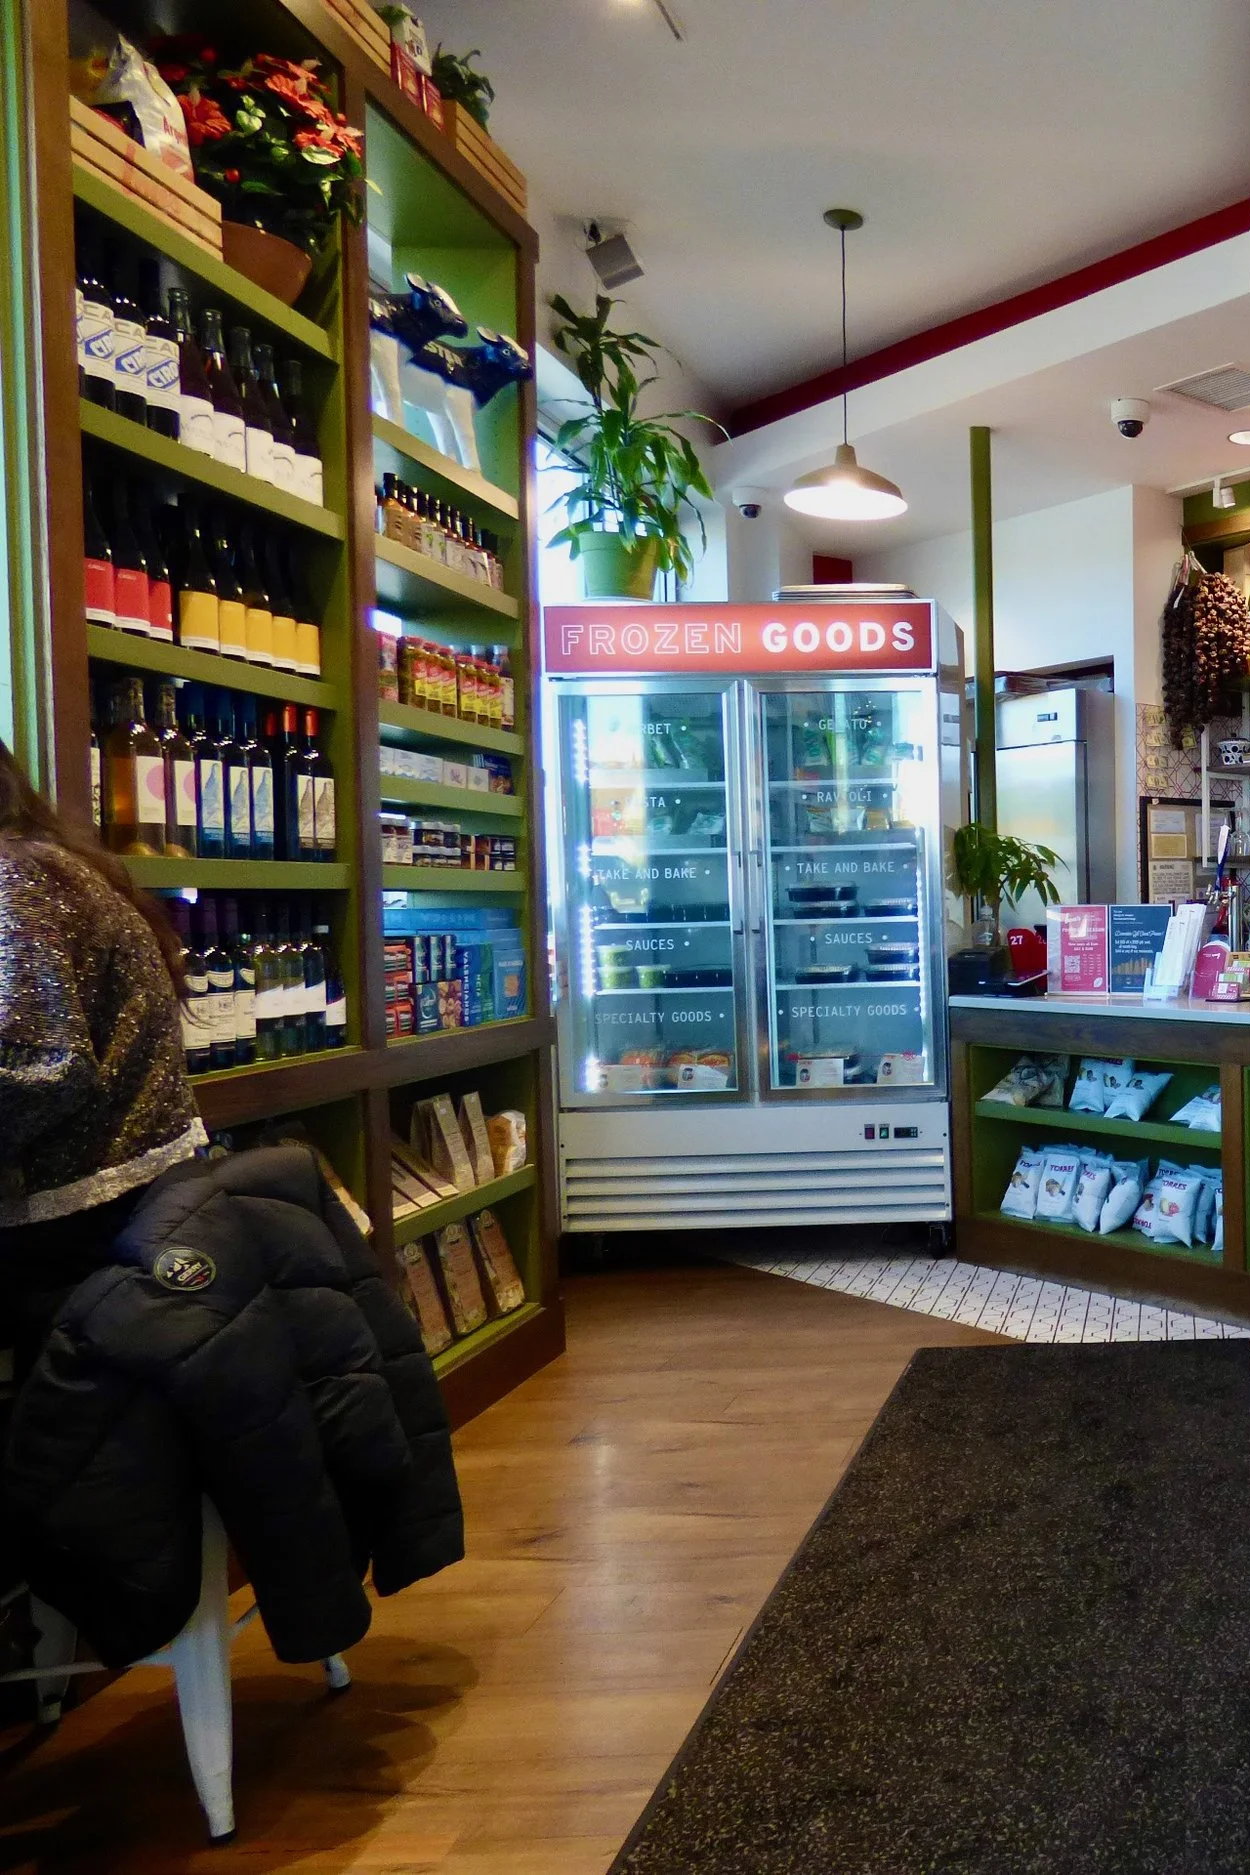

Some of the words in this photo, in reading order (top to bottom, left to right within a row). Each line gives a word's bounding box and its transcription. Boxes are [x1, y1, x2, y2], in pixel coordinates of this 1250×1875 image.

[561, 623, 742, 655] FROZEN
[762, 621, 915, 653] GOODS
[635, 868, 660, 880] AND
[665, 867, 697, 879] BAKE
[797, 862, 829, 874] TAKE
[834, 862, 859, 873] AND
[863, 861, 895, 873] BAKE
[626, 938, 675, 951] SAUCES
[825, 933, 873, 945] SAUCES
[1010, 935, 1024, 946] 27
[791, 1006, 861, 1018] SPECIALTY
[867, 1004, 907, 1016] GOODS
[594, 1012, 665, 1025] SPECIALTY
[671, 1011, 712, 1023] GOODS
